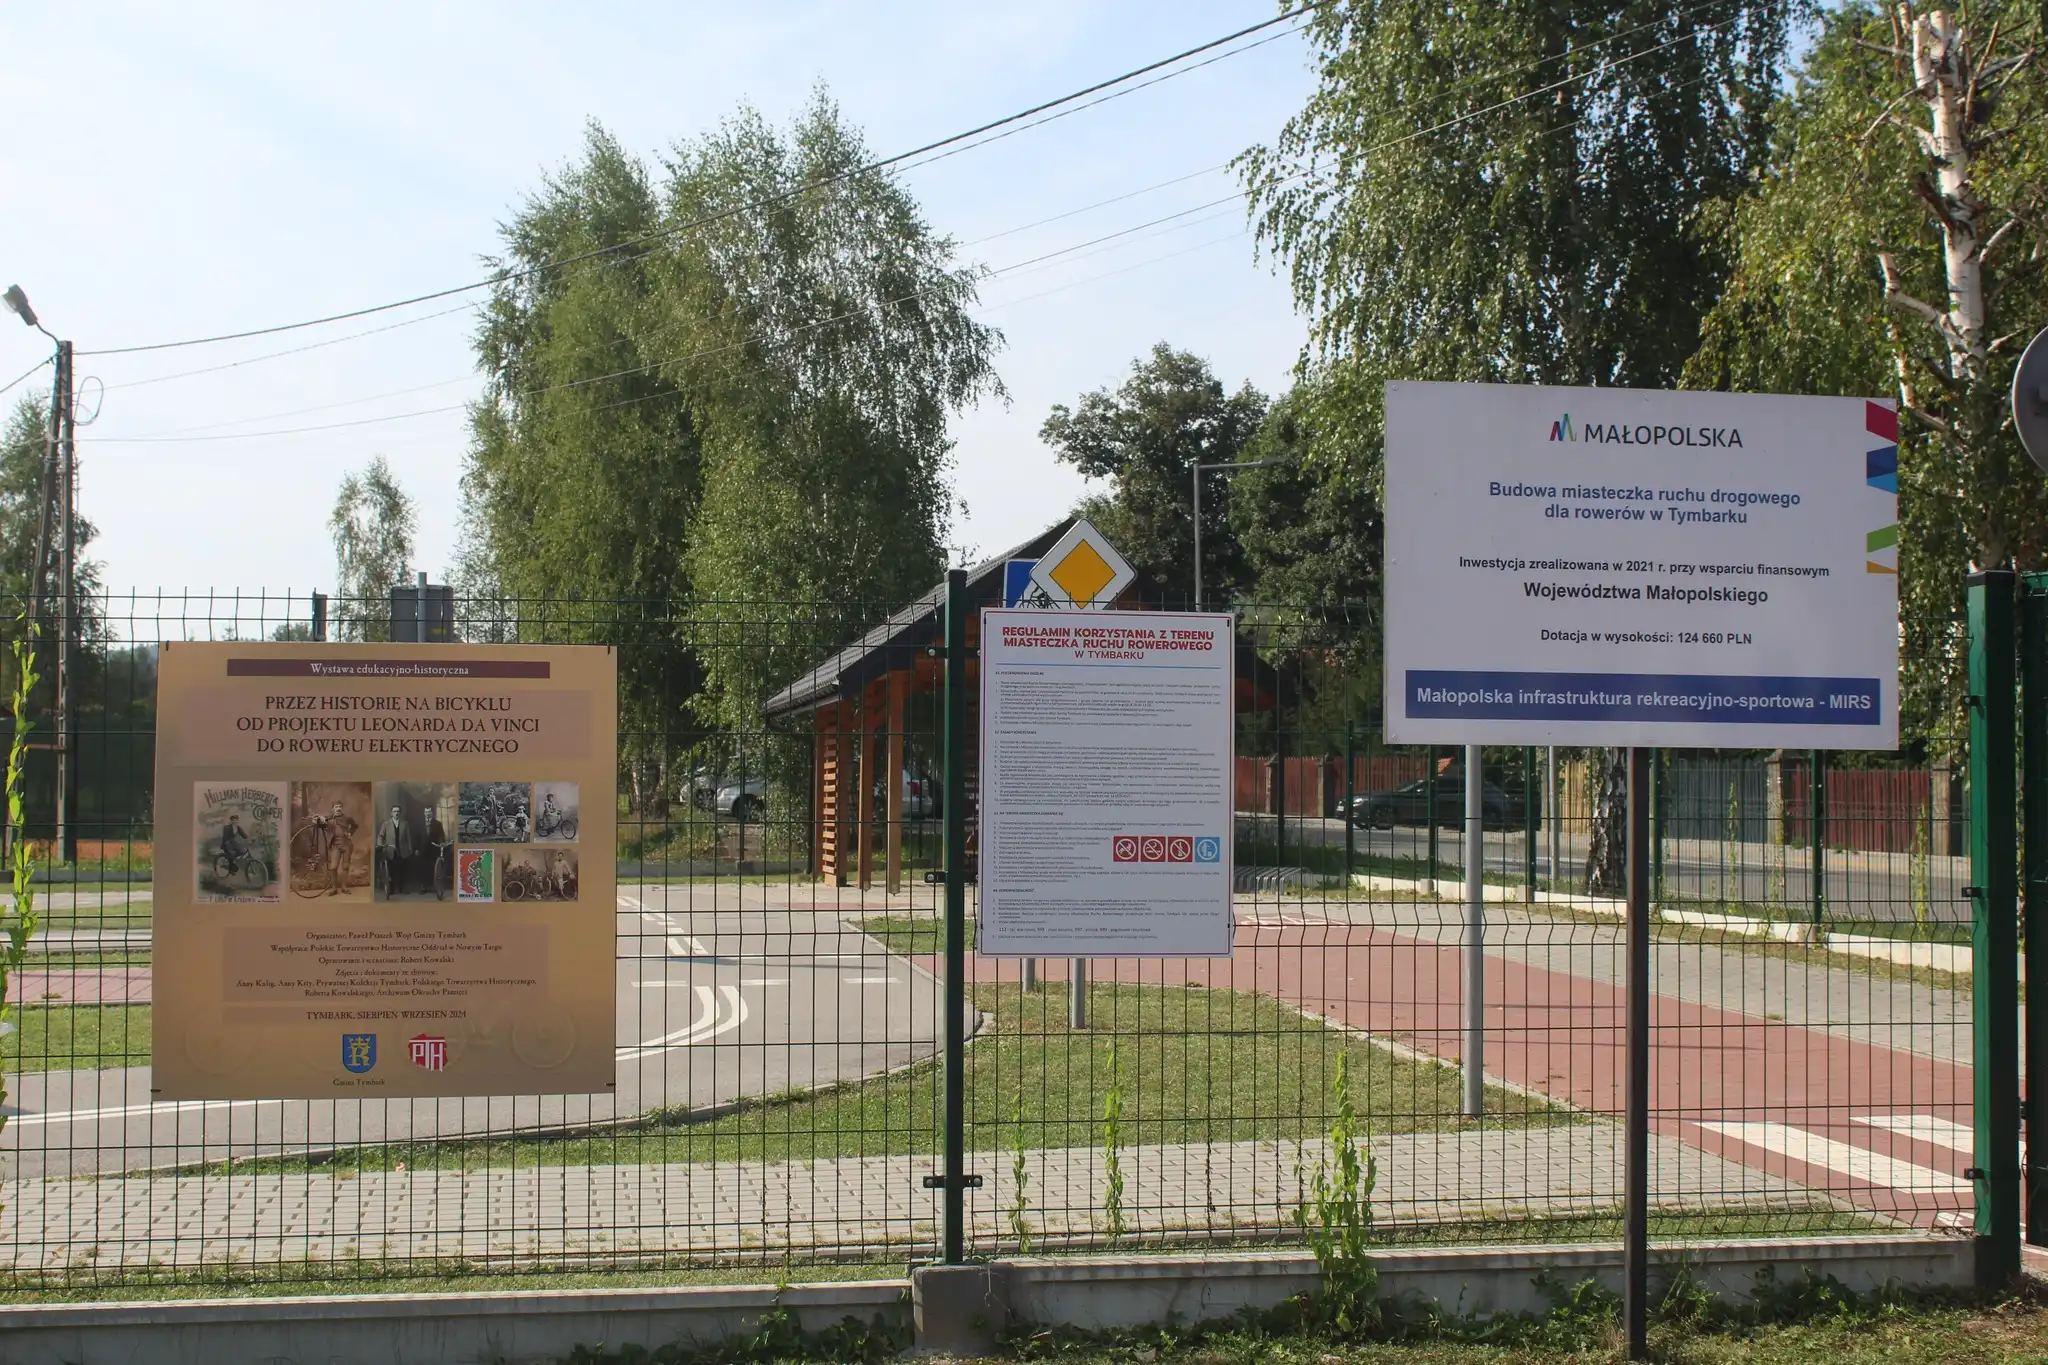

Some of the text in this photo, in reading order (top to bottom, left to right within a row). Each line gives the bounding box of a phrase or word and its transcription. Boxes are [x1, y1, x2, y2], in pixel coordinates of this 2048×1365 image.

[1585, 424, 1743, 448] MAŁOPOLSKA
[1490, 482, 1801, 508] Budowa miasteczka ruchu drogowego
[1544, 504, 1748, 524] dla rowerów w Tymbarku
[1459, 556, 1830, 578] Inwestycja zrealizowana w 2021 r. przy wsparciu finansowym
[1524, 582, 1768, 606] Województwa Małopolskiego
[1002, 626, 1214, 640] REGULAMIN KORZYSTANIA Z TERENU
[1541, 630, 1752, 644] Dotacja w wysokości: 124 660 PLN
[1004, 637, 1213, 651] MIASTECZKA RUCHU ROWEROWEGO
[1074, 650, 1144, 660] W TYMBARKU
[310, 662, 469, 678] Wystawa edukacyjno-historyczna
[265, 696, 512, 713] PRZEZ HISTORIĘ NA BICYKLU
[1417, 687, 1514, 706] Małopolska
[1518, 689, 1632, 706] infrastruktura
[1637, 691, 1814, 710] rekreacyjno-sportowa
[1830, 694, 1872, 710] MIRS
[236, 717, 540, 735] OD PROJEKTU LEONARDA DA VINCI
[257, 738, 519, 753] DO ROWERU ELEKTRYCZNEGO
[438, 930, 466, 940] Tymbark
[336, 944, 379, 953] Towarzystwo
[381, 944, 420, 952] Historyczne
[456, 944, 482, 952] Nowym
[424, 956, 455, 964] Kowalski
[449, 1010, 466, 1018] 2024
[409, 1039, 446, 1072] PTH
[356, 1079, 386, 1087] Tymbark
